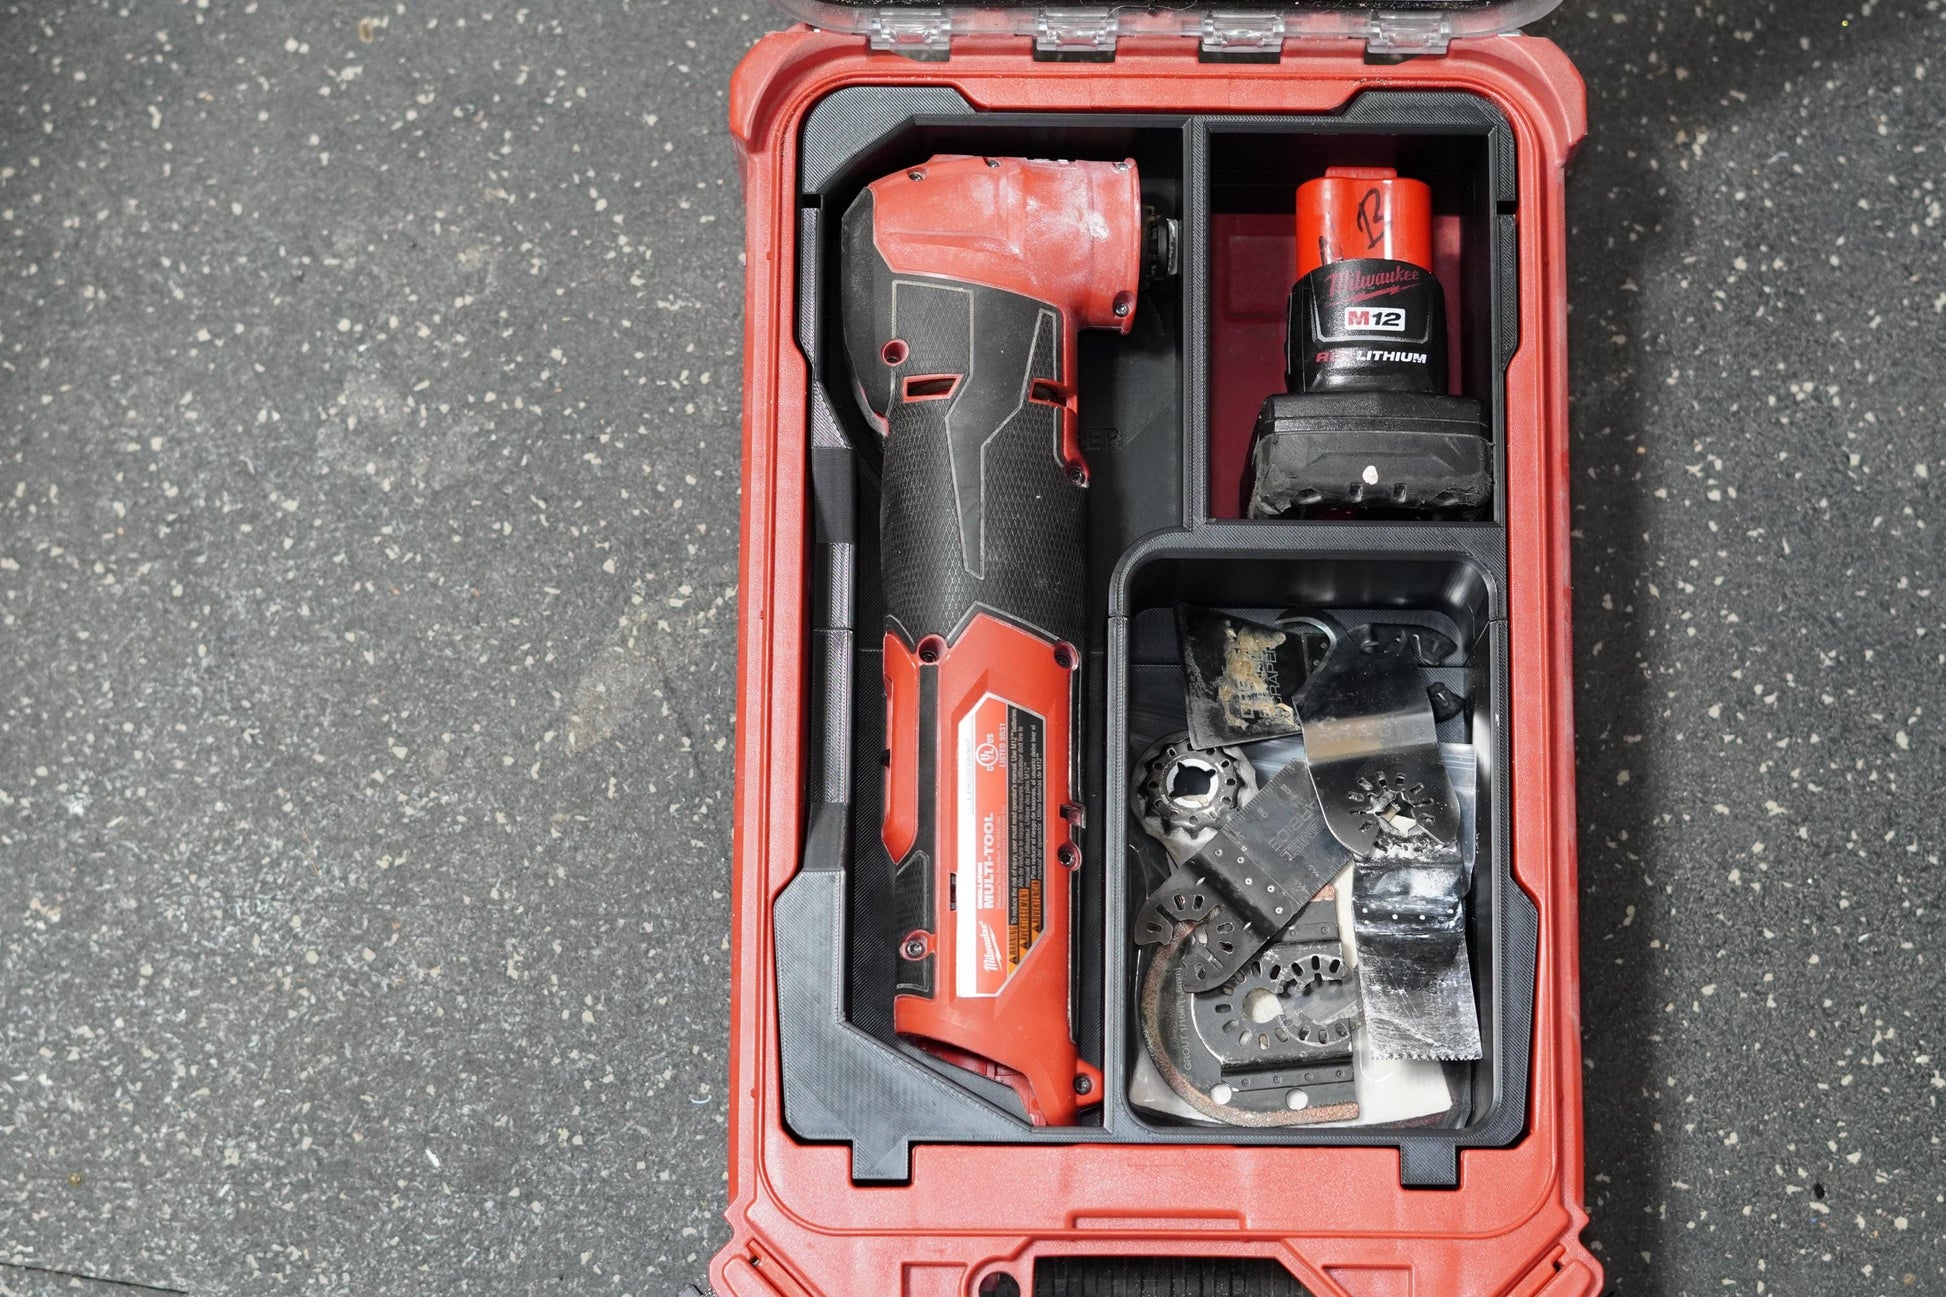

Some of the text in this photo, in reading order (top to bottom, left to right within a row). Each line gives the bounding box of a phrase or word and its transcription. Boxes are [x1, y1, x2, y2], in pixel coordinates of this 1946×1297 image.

[1324, 266, 1420, 298] Milwaukee
[1346, 310, 1402, 327] M12
[983, 812, 994, 908] MULTI-TOOL
[1019, 889, 1029, 940] AVERTISSEMENT
[1032, 881, 1040, 923] ADVERTENCIA
[979, 923, 998, 973] Milwaukee
[1009, 926, 1018, 956] WARNING
[1182, 1036, 1192, 1070] GROUT
